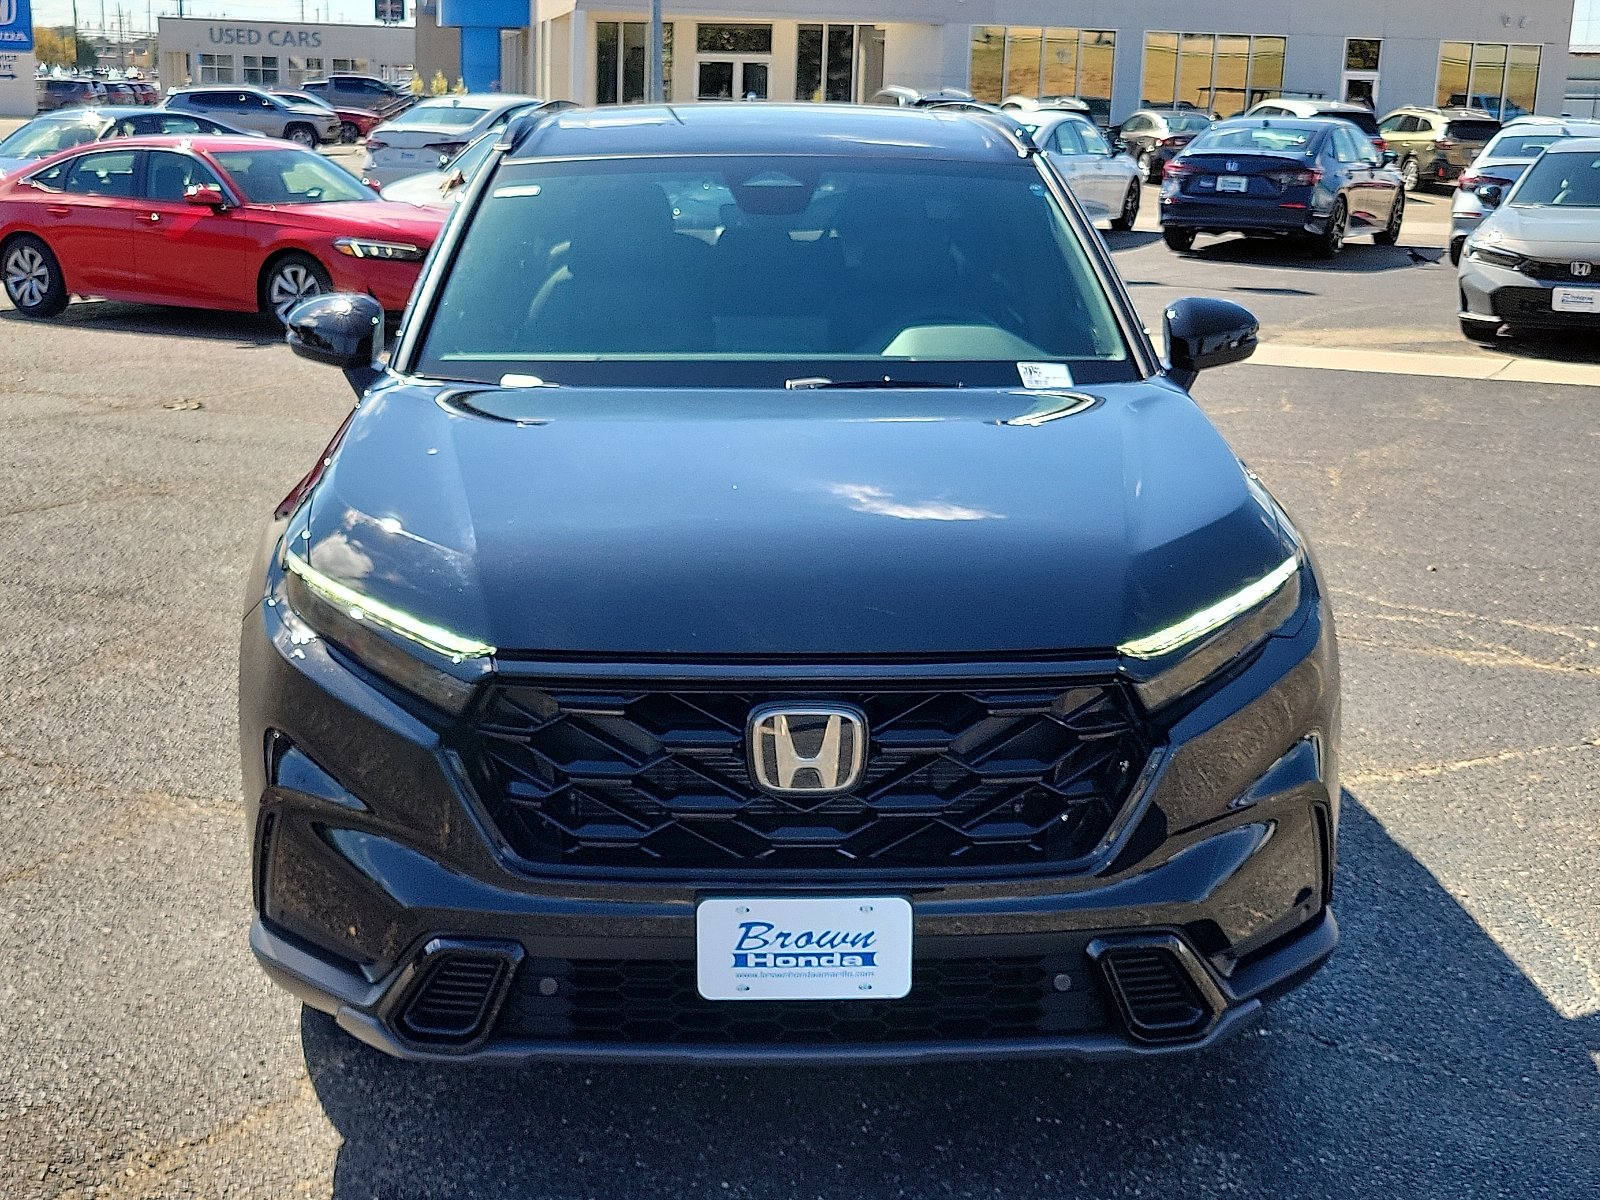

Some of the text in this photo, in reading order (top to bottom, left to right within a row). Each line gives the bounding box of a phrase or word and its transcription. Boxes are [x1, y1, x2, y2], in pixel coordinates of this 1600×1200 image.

[209, 27, 321, 48] USED CARS
[735, 921, 877, 951] Brown
[746, 952, 864, 968] Honda
